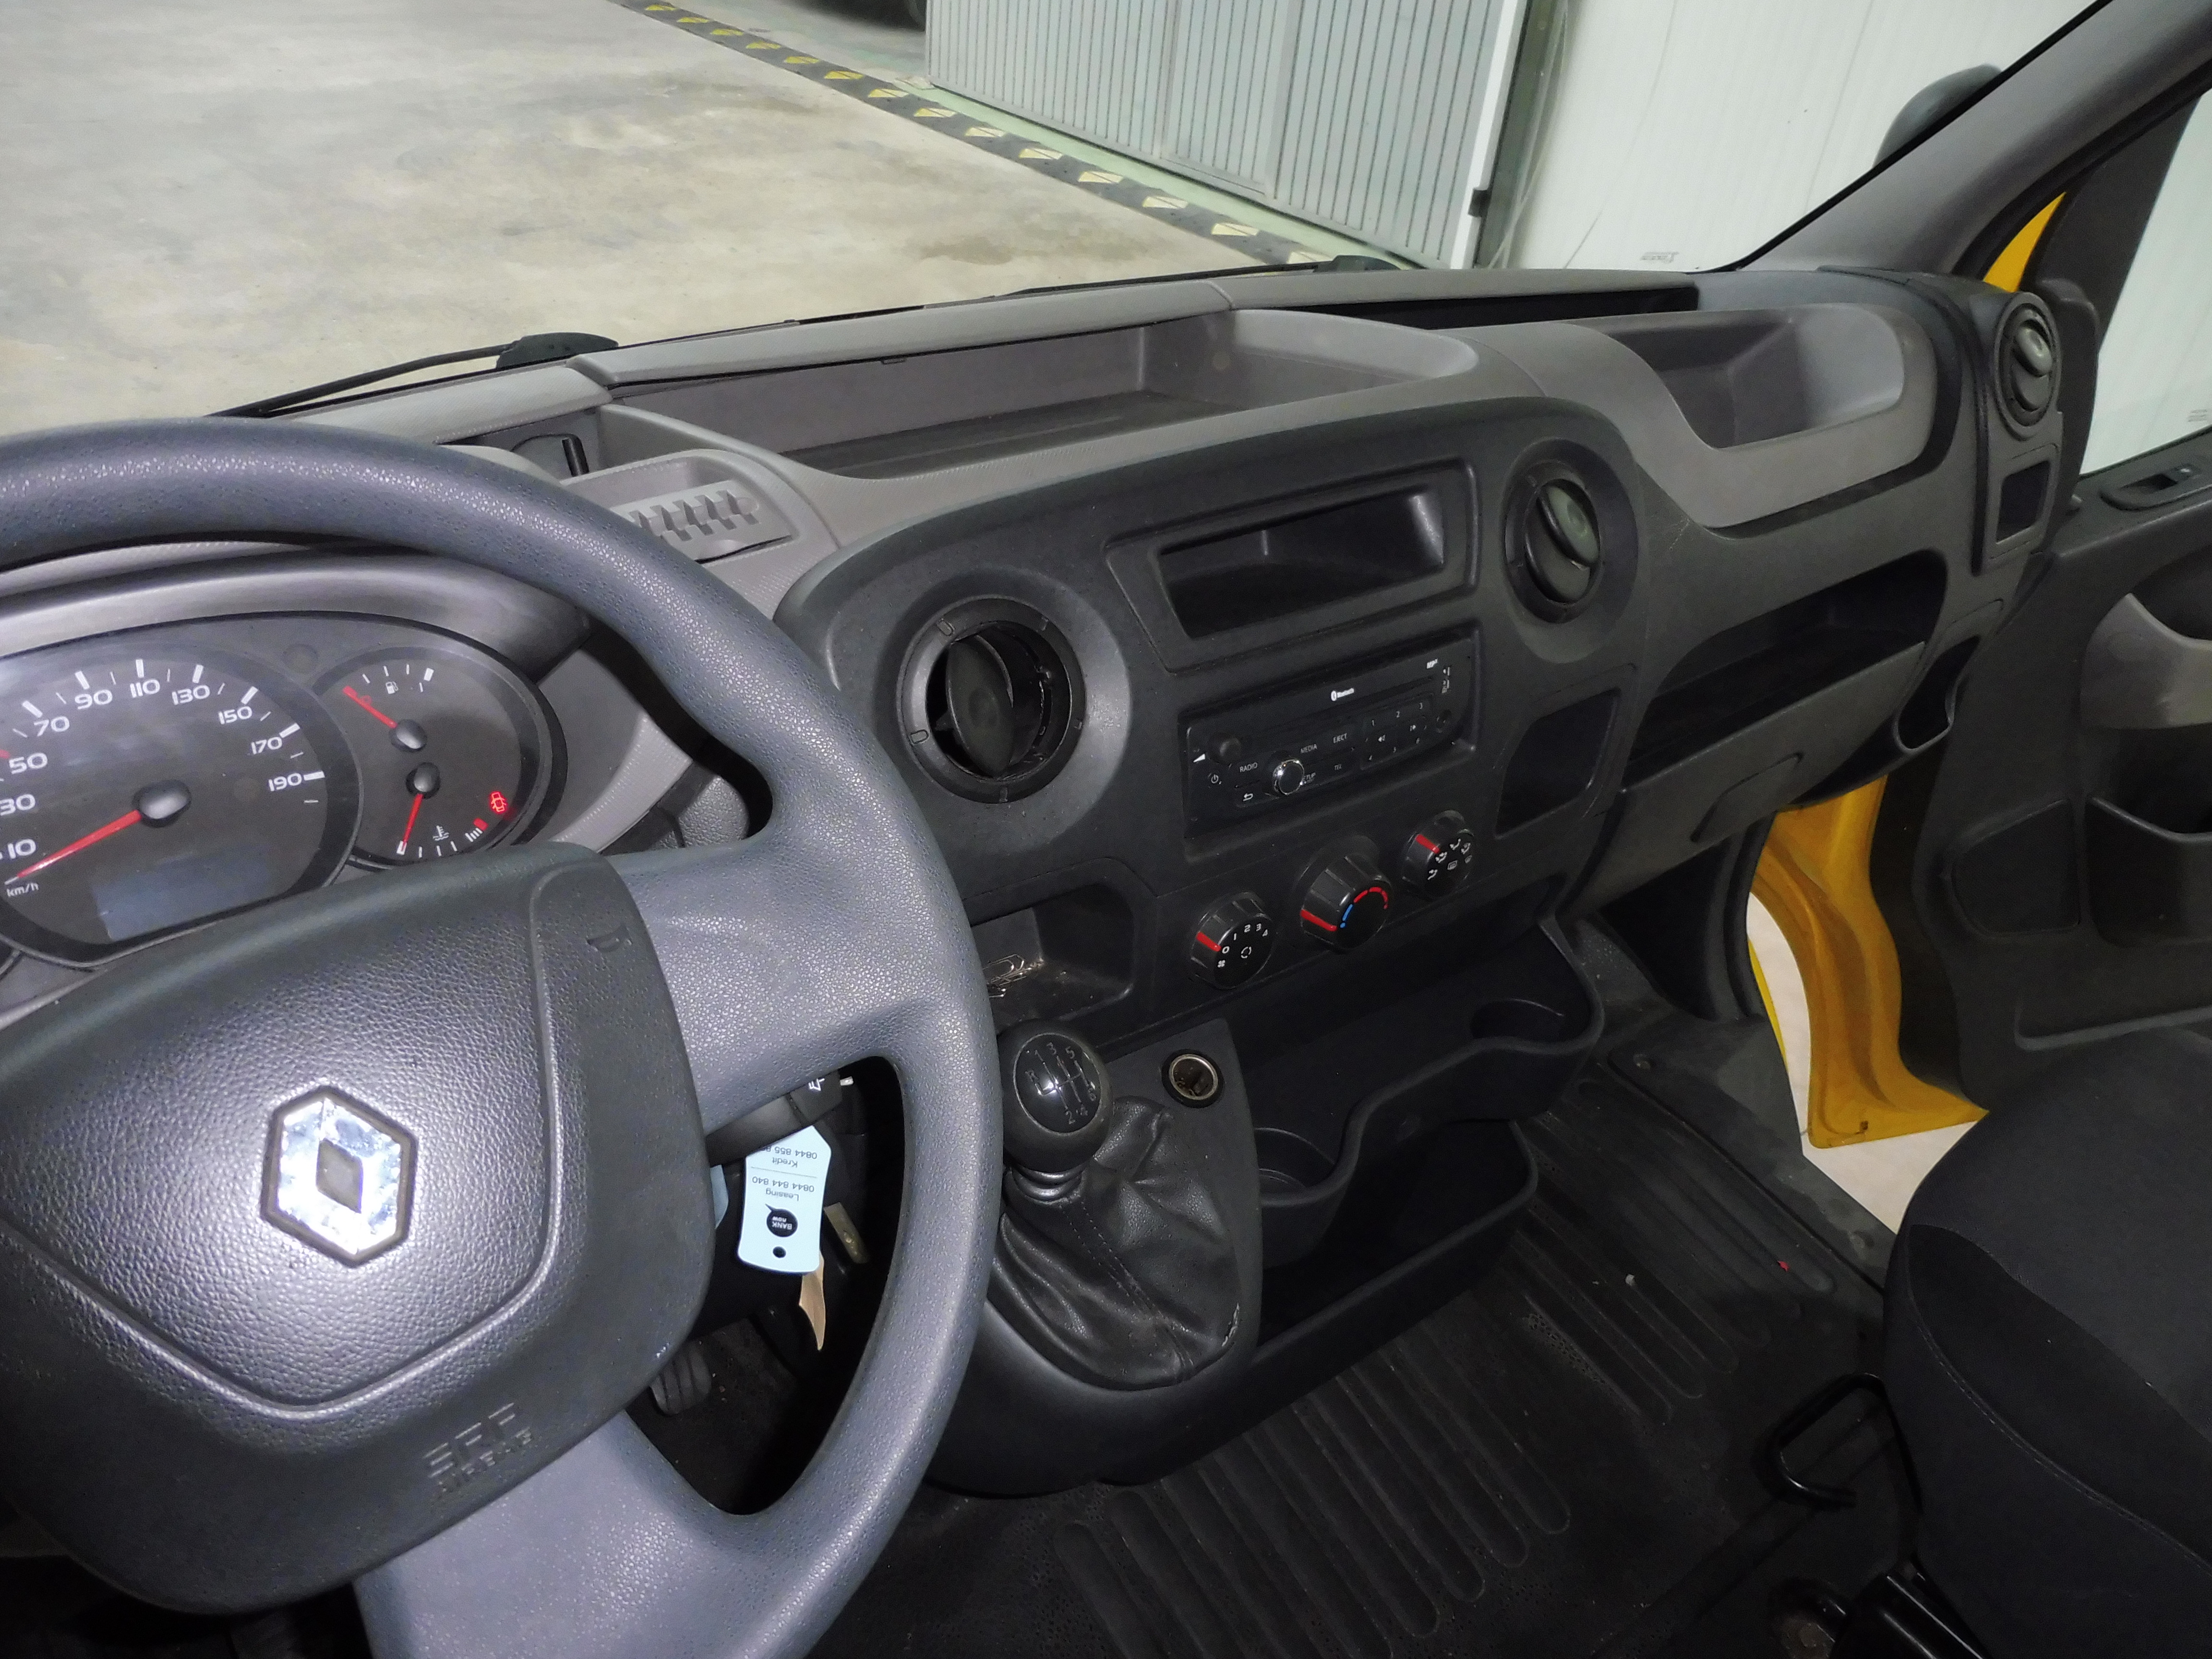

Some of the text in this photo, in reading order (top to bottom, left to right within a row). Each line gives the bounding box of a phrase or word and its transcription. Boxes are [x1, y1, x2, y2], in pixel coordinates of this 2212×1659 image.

[130, 679, 161, 698] 110
[171, 685, 210, 705] 130
[74, 689, 113, 709] 90
[218, 706, 253, 725] 150
[33, 715, 70, 737] 70
[250, 736, 282, 755] 170
[1333, 733, 1347, 744] EJECT
[1300, 744, 1318, 754] MEDIA
[8, 752, 48, 774] 50
[1239, 762, 1258, 773] RADIO
[268, 772, 302, 792] 190
[0, 793, 36, 816] 30
[7, 839, 36, 859] 10
[6, 882, 39, 897] km/h
[1244, 924, 1251, 933] 2
[1256, 923, 1262, 932] 3
[1262, 929, 1268, 938] 4
[1233, 933, 1237, 941] 1
[1222, 946, 1230, 954] 0
[1046, 1042, 1057, 1056] 3
[1065, 1046, 1075, 1059] 5
[1064, 1110, 1076, 1125] 2
[774, 1146, 792, 1155] 855
[795, 1149, 817, 1159] 0844
[772, 1157, 798, 1168] Kredit
[752, 1176, 815, 1192] 0844 844 840
[766, 1188, 799, 1202] Leasing
[772, 1221, 793, 1230] BANK
